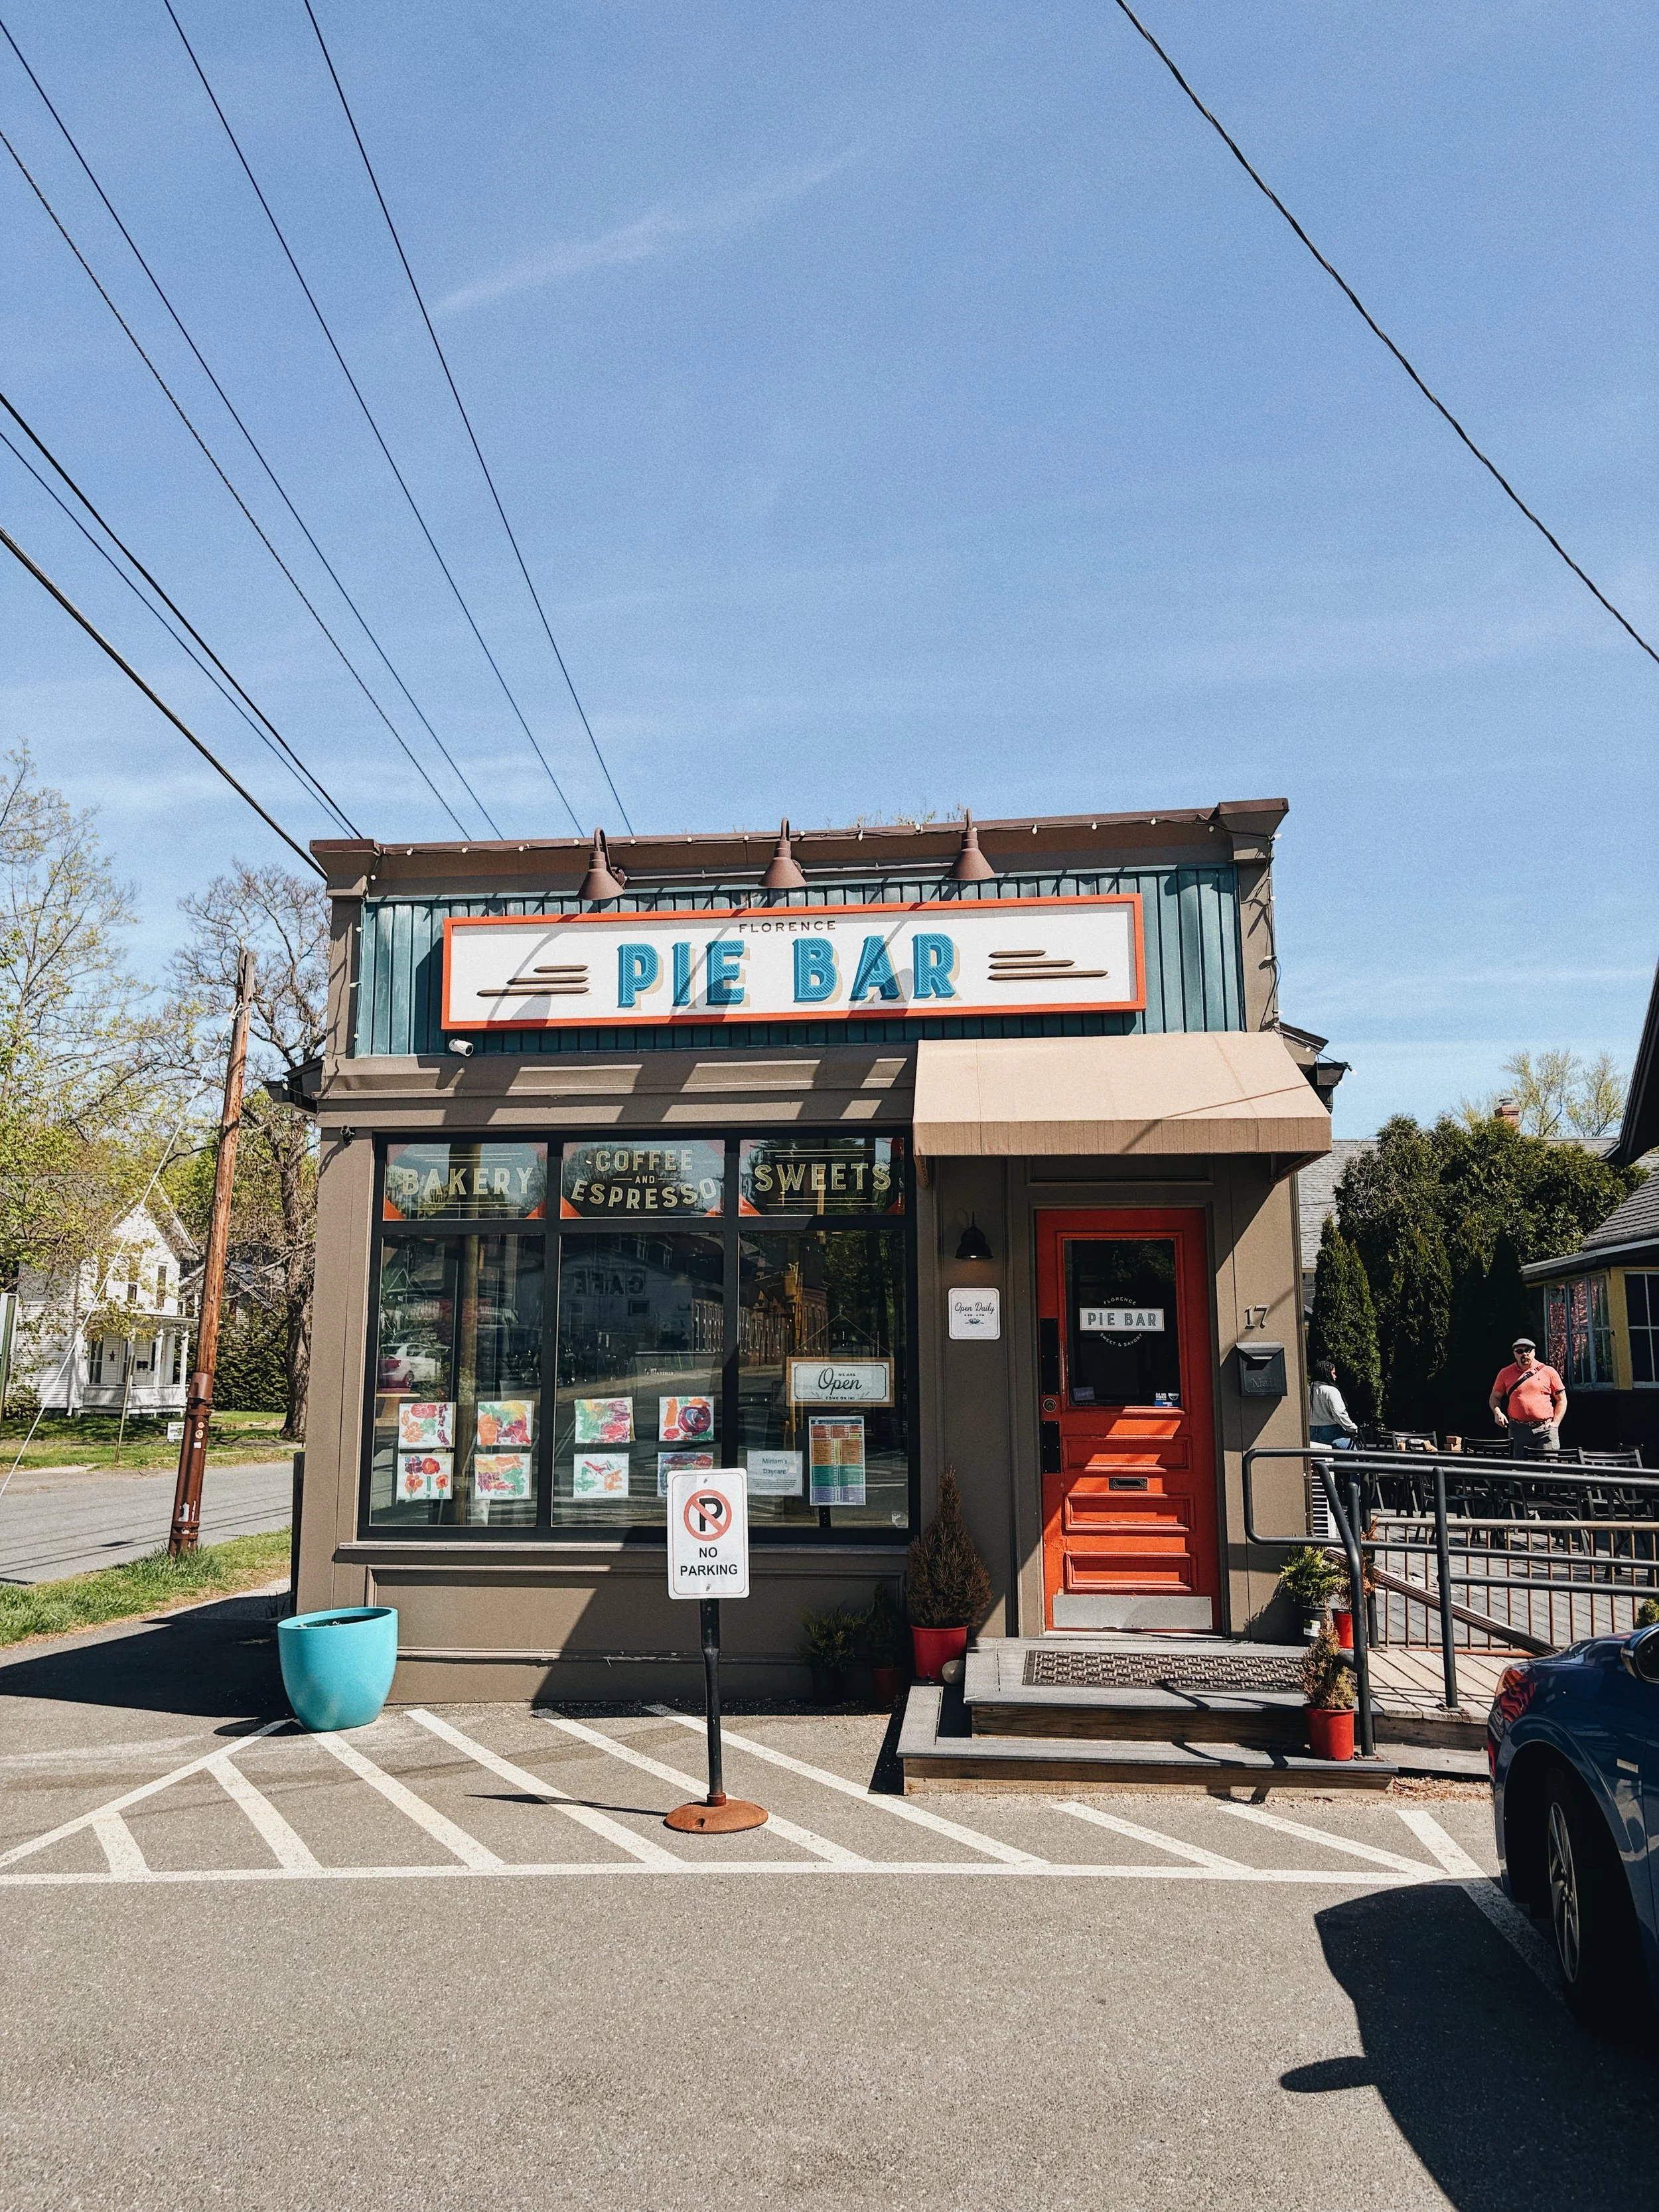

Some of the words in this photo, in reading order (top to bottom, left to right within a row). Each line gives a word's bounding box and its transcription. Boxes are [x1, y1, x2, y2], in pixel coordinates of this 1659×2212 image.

[739, 921, 836, 933] FLORENCE
[616, 940, 749, 1009] PIE
[792, 933, 960, 1005] BAR
[596, 1149, 693, 1171] COFFEE
[402, 1167, 533, 1195] BAKERY
[635, 1175, 655, 1184] AND
[754, 1163, 891, 1191] SWEETS
[571, 1177, 717, 1209] ESPRESSO
[954, 1301, 973, 1314] Open
[975, 1301, 995, 1314] Daily
[1103, 1297, 1137, 1305] FLORENCE
[1088, 1312, 1115, 1325] PIE
[1124, 1313, 1156, 1326] BAR
[1244, 1304, 1270, 1329] 17
[1100, 1332, 1116, 1346] SWEET
[1123, 1333, 1143, 1347] SAVORY
[818, 1367, 862, 1395] Open
[699, 1547, 718, 1558] NO
[680, 1564, 738, 1576] PARKING
